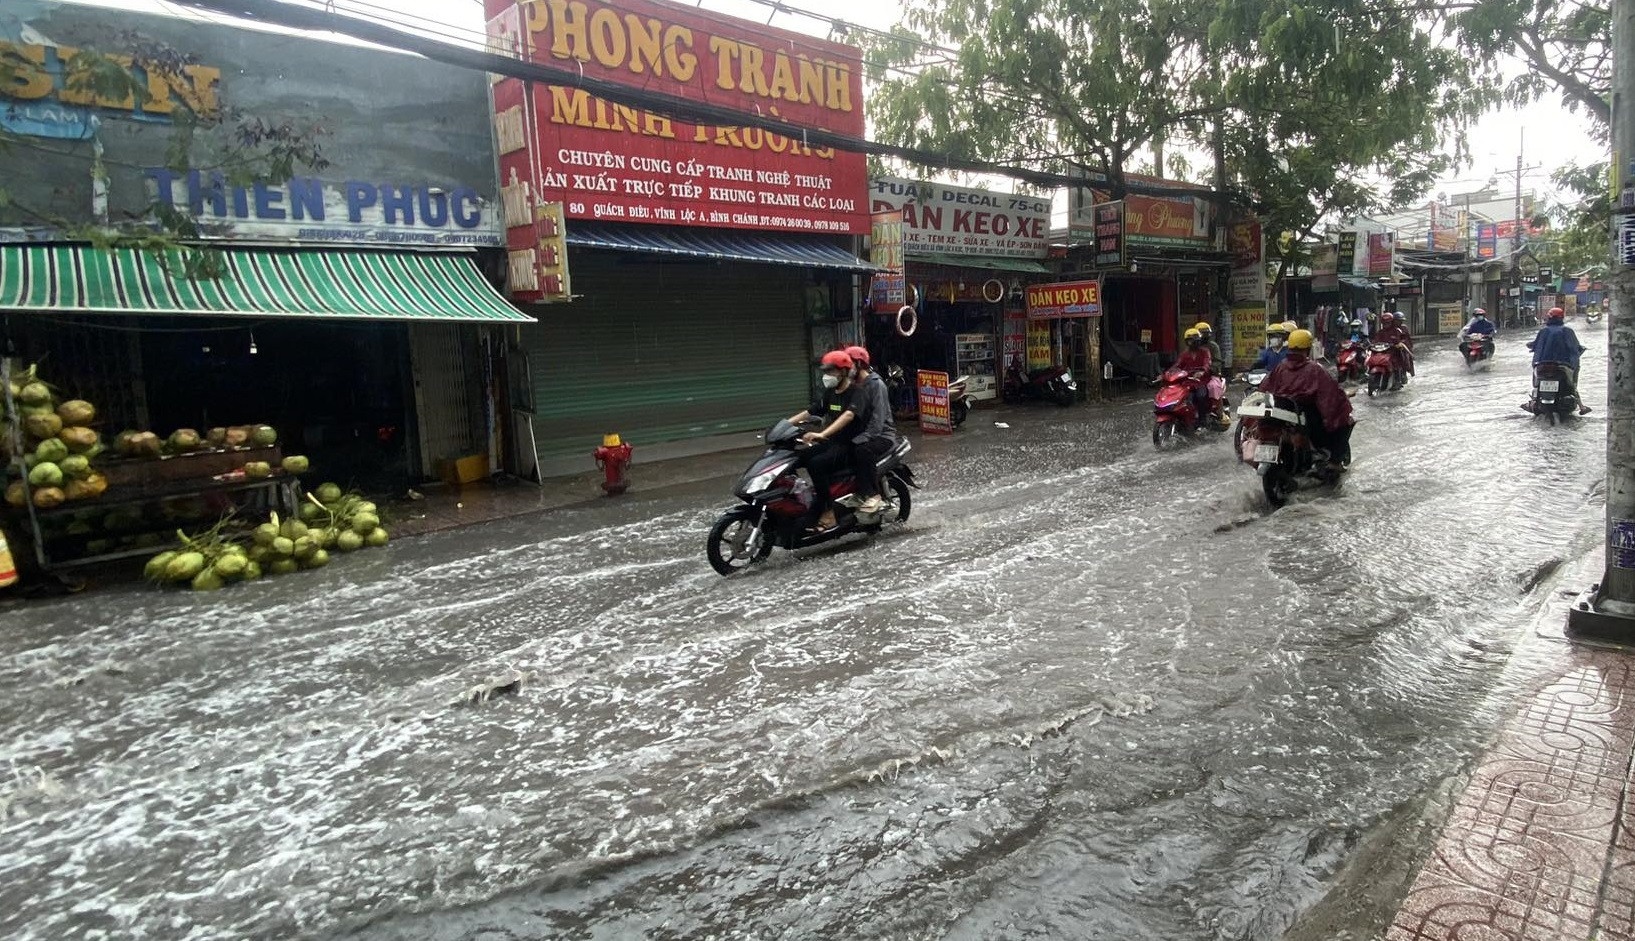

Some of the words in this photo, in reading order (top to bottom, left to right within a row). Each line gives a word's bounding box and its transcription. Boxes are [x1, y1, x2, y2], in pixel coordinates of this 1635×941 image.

[527, 0, 697, 82] PHONG
[709, 35, 853, 112] TRANH
[548, 85, 675, 139] MINH
[558, 149, 625, 170] CHUYÊN
[630, 157, 672, 173] CUNG
[676, 158, 704, 177] CẤP
[707, 164, 752, 182] TRANH
[757, 169, 790, 188] NGHỆ
[794, 174, 833, 191] THUẬT
[541, 166, 568, 189] ẢN
[573, 171, 618, 192] XUẤT
[623, 180, 665, 198] TRỰC
[669, 178, 702, 198] TIẾP
[709, 187, 755, 203] KHUNG
[759, 191, 801, 207] TRANH
[803, 193, 827, 208] CÁC
[830, 198, 855, 213] LOẠI
[942, 189, 1002, 208] DECAL
[570, 203, 585, 214] 80
[594, 202, 624, 217] QUÁCH
[681, 207, 696, 223] LỘC
[710, 210, 730, 223] BÌNH
[952, 208, 1010, 237] KEO
[1015, 215, 1046, 240] XE
[1030, 289, 1053, 307] DÁN
[1055, 288, 1079, 305] KEO
[1082, 287, 1098, 303] XE
